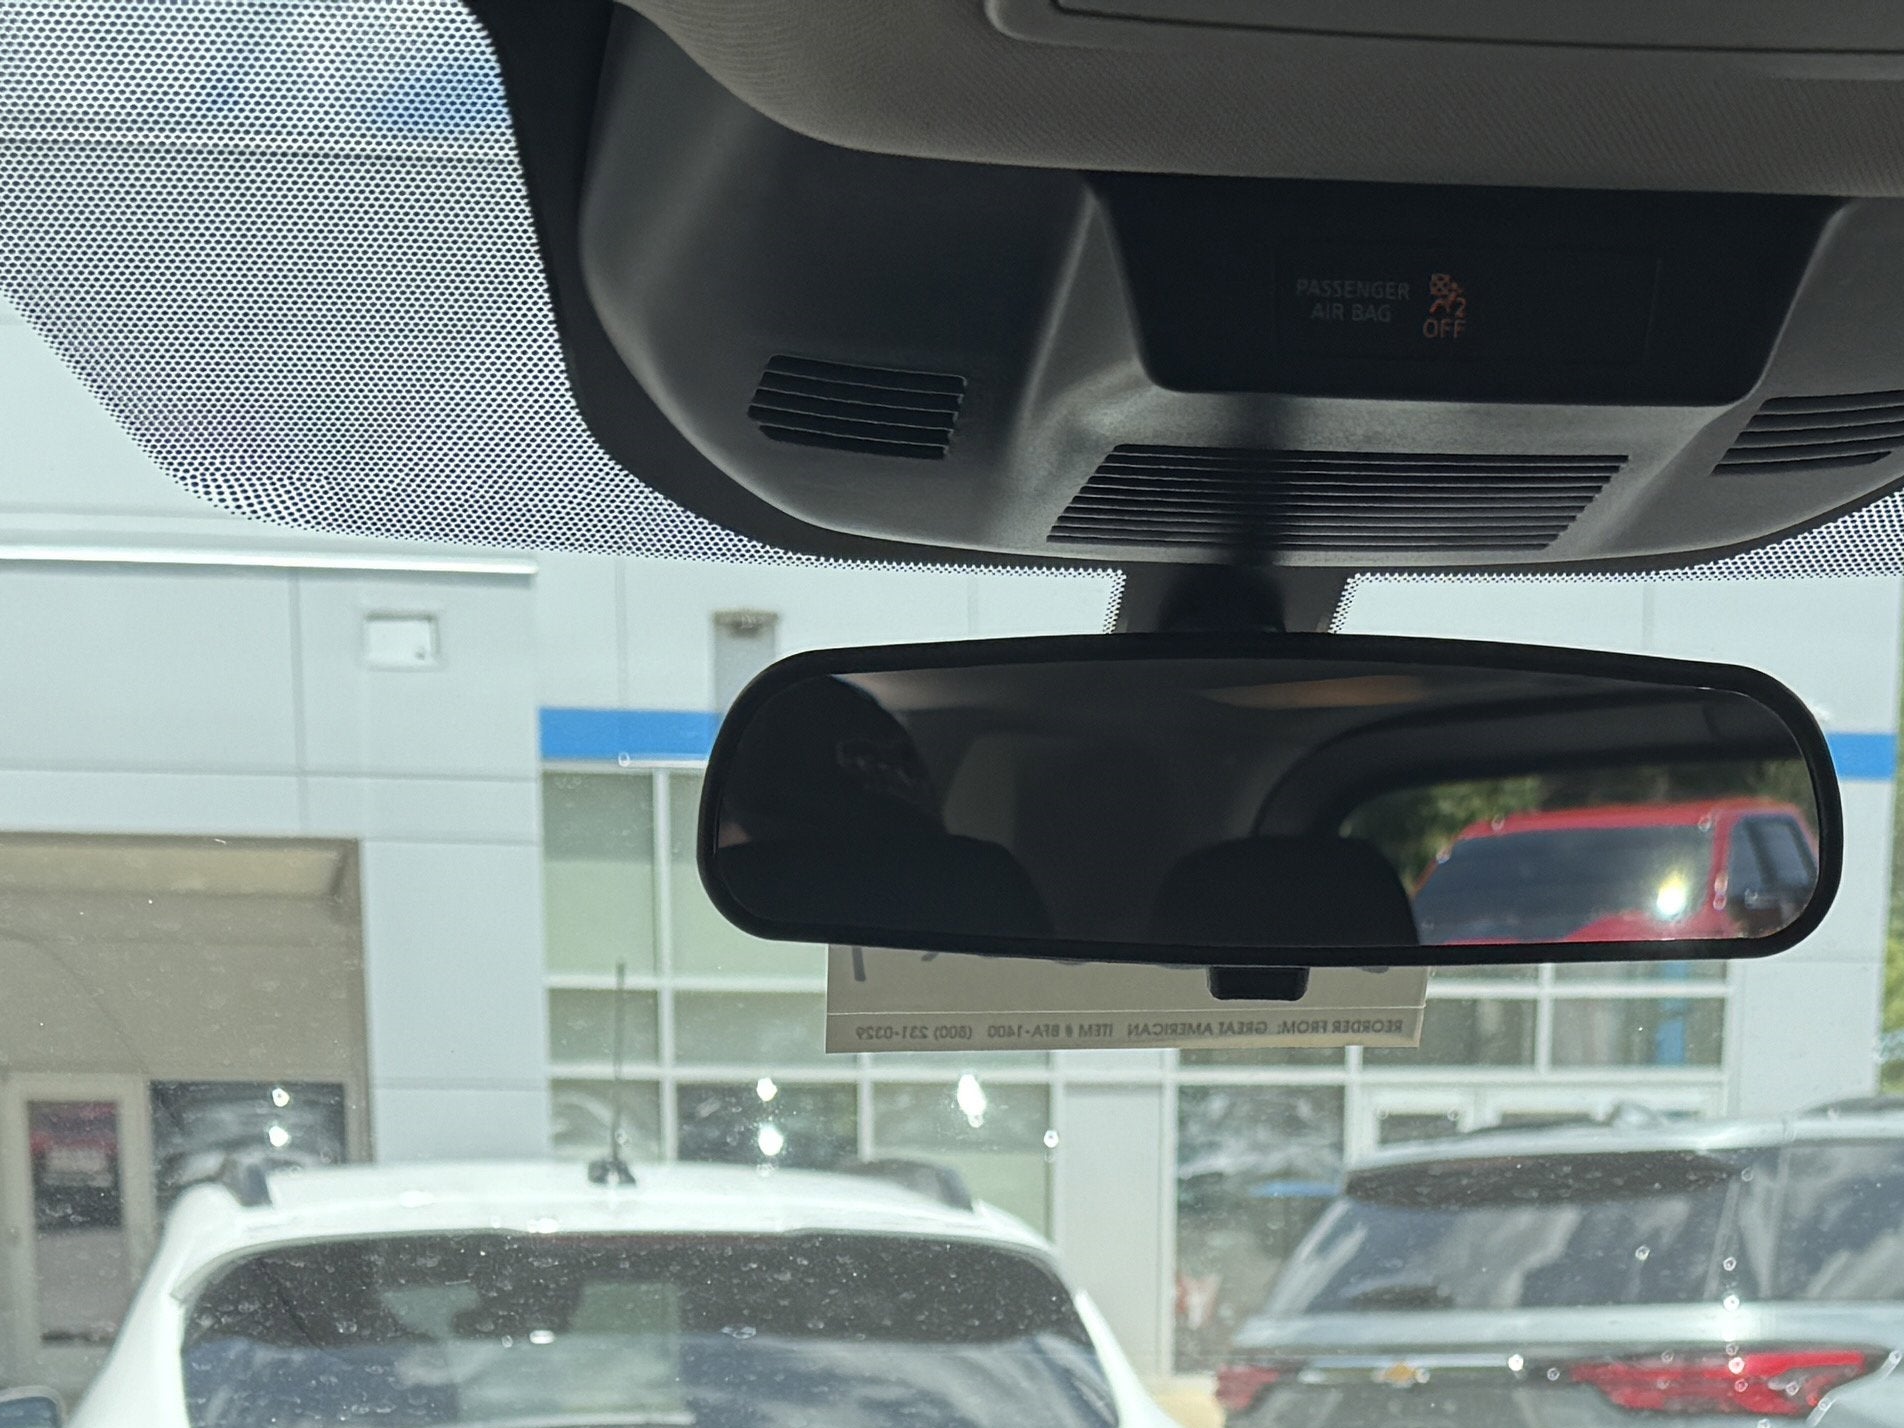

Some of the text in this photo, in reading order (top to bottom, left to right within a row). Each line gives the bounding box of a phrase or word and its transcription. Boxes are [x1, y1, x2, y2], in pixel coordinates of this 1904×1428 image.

[1296, 279, 1410, 301] PASSENGER
[1311, 303, 1392, 323] AIR BAG
[1423, 319, 1466, 340] OFF
